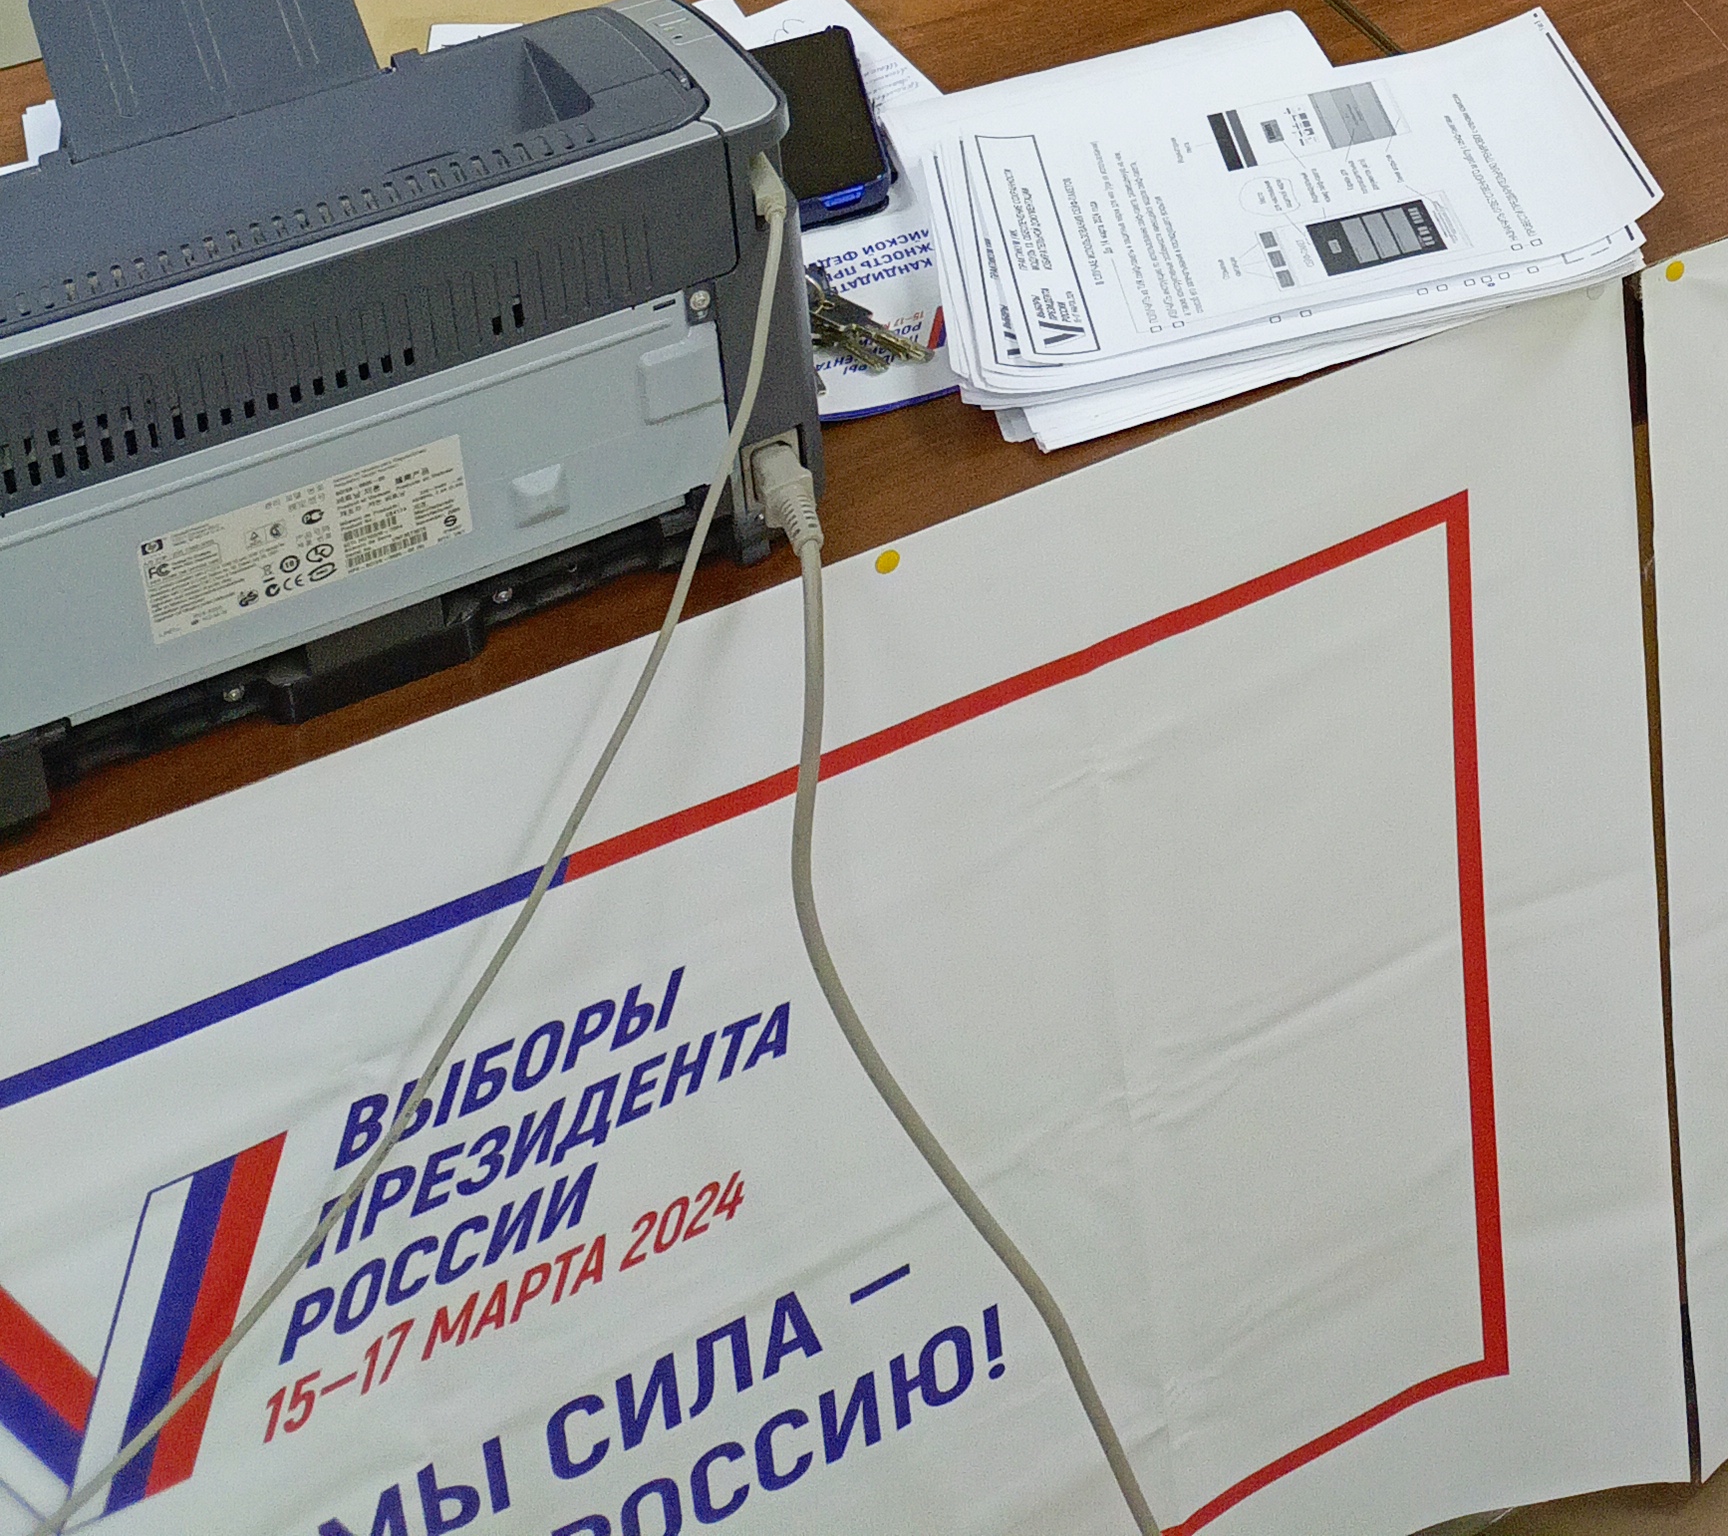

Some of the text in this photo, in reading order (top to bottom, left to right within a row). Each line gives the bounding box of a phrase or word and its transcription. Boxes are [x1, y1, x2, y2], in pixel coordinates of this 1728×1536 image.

[304, 1001, 793, 1271] ПРЕЗИДЕНТА
[333, 965, 686, 1171] ВЫБОРЫ
[278, 1161, 599, 1366] РОССИИ
[421, 1234, 607, 1362] МАРТА
[619, 1170, 745, 1272] 2024
[544, 1291, 824, 1482] СИЛА
[550, 1303, 1007, 1536] ОССИЮ!
